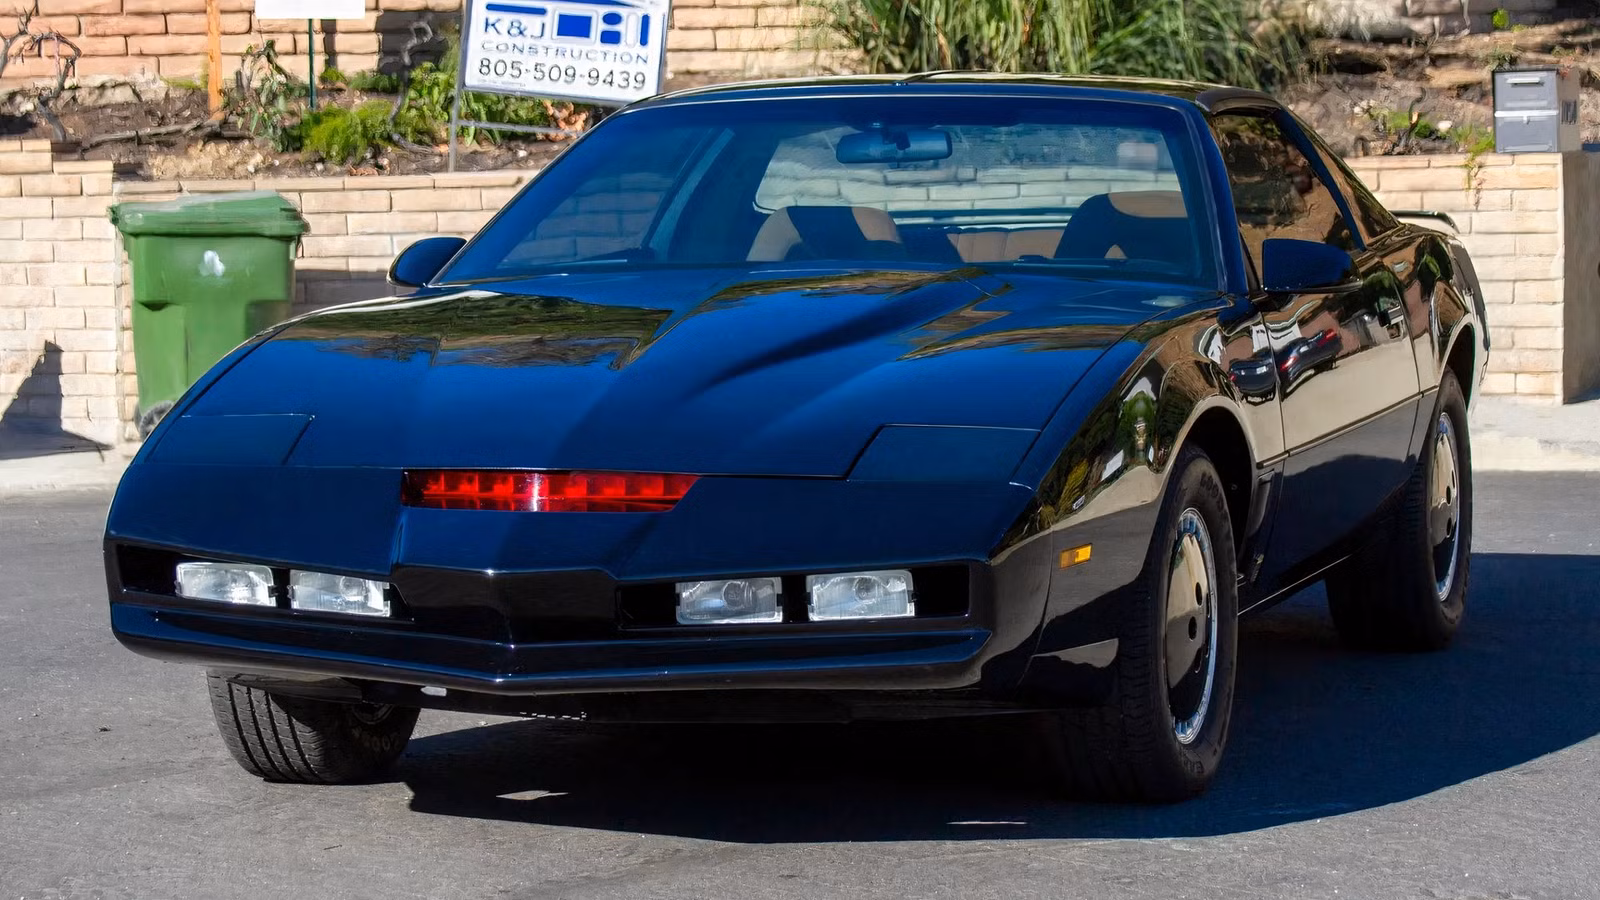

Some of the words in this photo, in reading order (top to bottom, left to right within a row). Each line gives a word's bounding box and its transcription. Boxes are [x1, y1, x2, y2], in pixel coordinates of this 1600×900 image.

[484, 17, 546, 40] K&J
[481, 40, 649, 65] CONSTRUCTION
[478, 57, 647, 91] 805-509-9439
